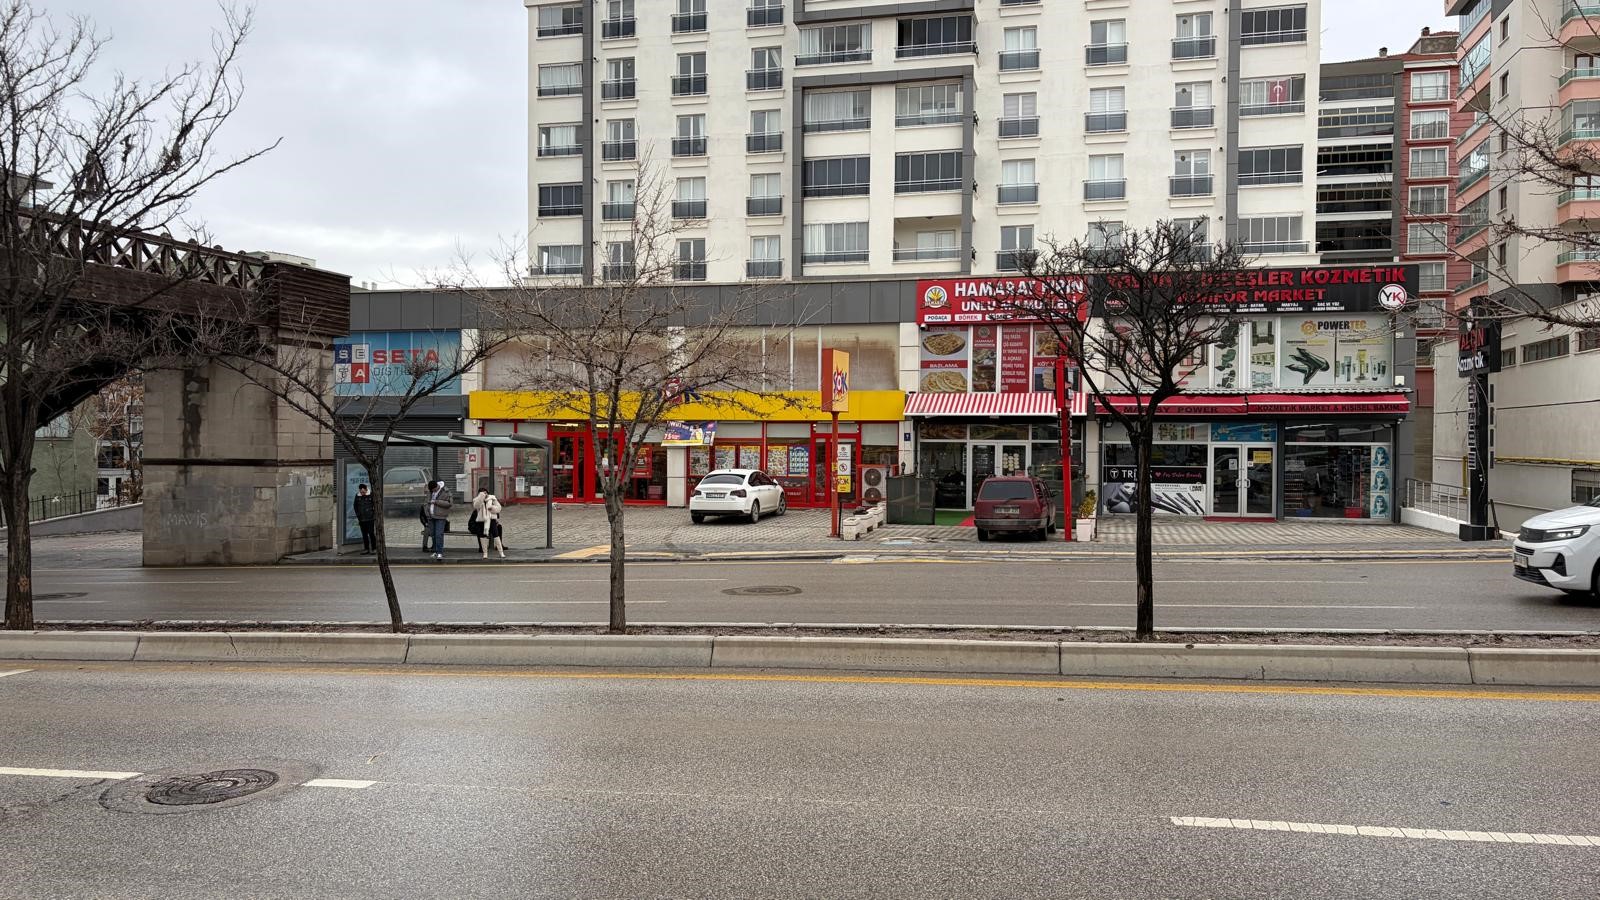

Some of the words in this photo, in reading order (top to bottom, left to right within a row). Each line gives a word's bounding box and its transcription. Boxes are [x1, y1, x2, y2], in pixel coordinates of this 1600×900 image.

[1301, 267, 1406, 285] KOZMETİK
[1254, 288, 1327, 303] MARKET
[1317, 319, 1367, 331] POWERTEC
[372, 349, 439, 365] SETA
